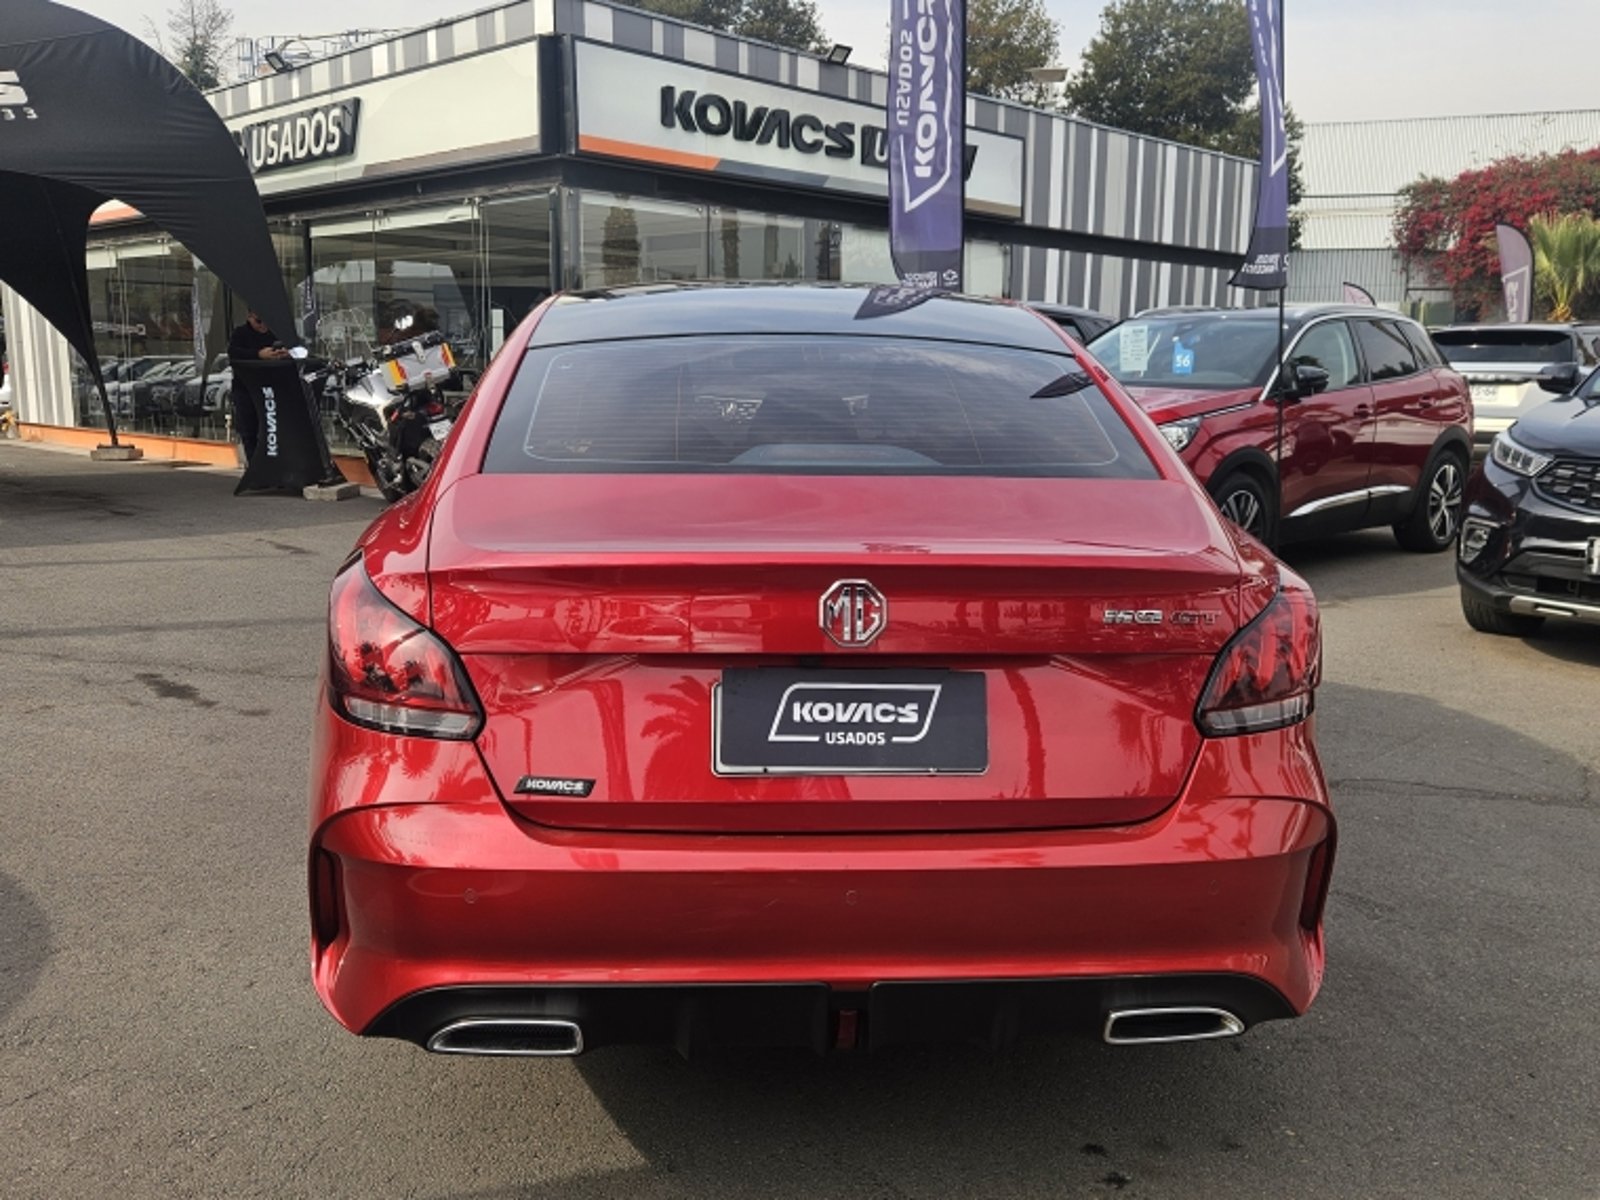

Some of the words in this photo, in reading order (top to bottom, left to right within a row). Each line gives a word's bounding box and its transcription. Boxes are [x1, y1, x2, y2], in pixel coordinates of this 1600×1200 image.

[251, 107, 341, 168] USADOS
[660, 85, 855, 159] KOVACS
[262, 386, 278, 456] KOVACS
[826, 586, 881, 641] MG
[792, 701, 919, 723] KOVACS
[825, 732, 886, 745] USADOS
[525, 778, 584, 790] KOVACS
